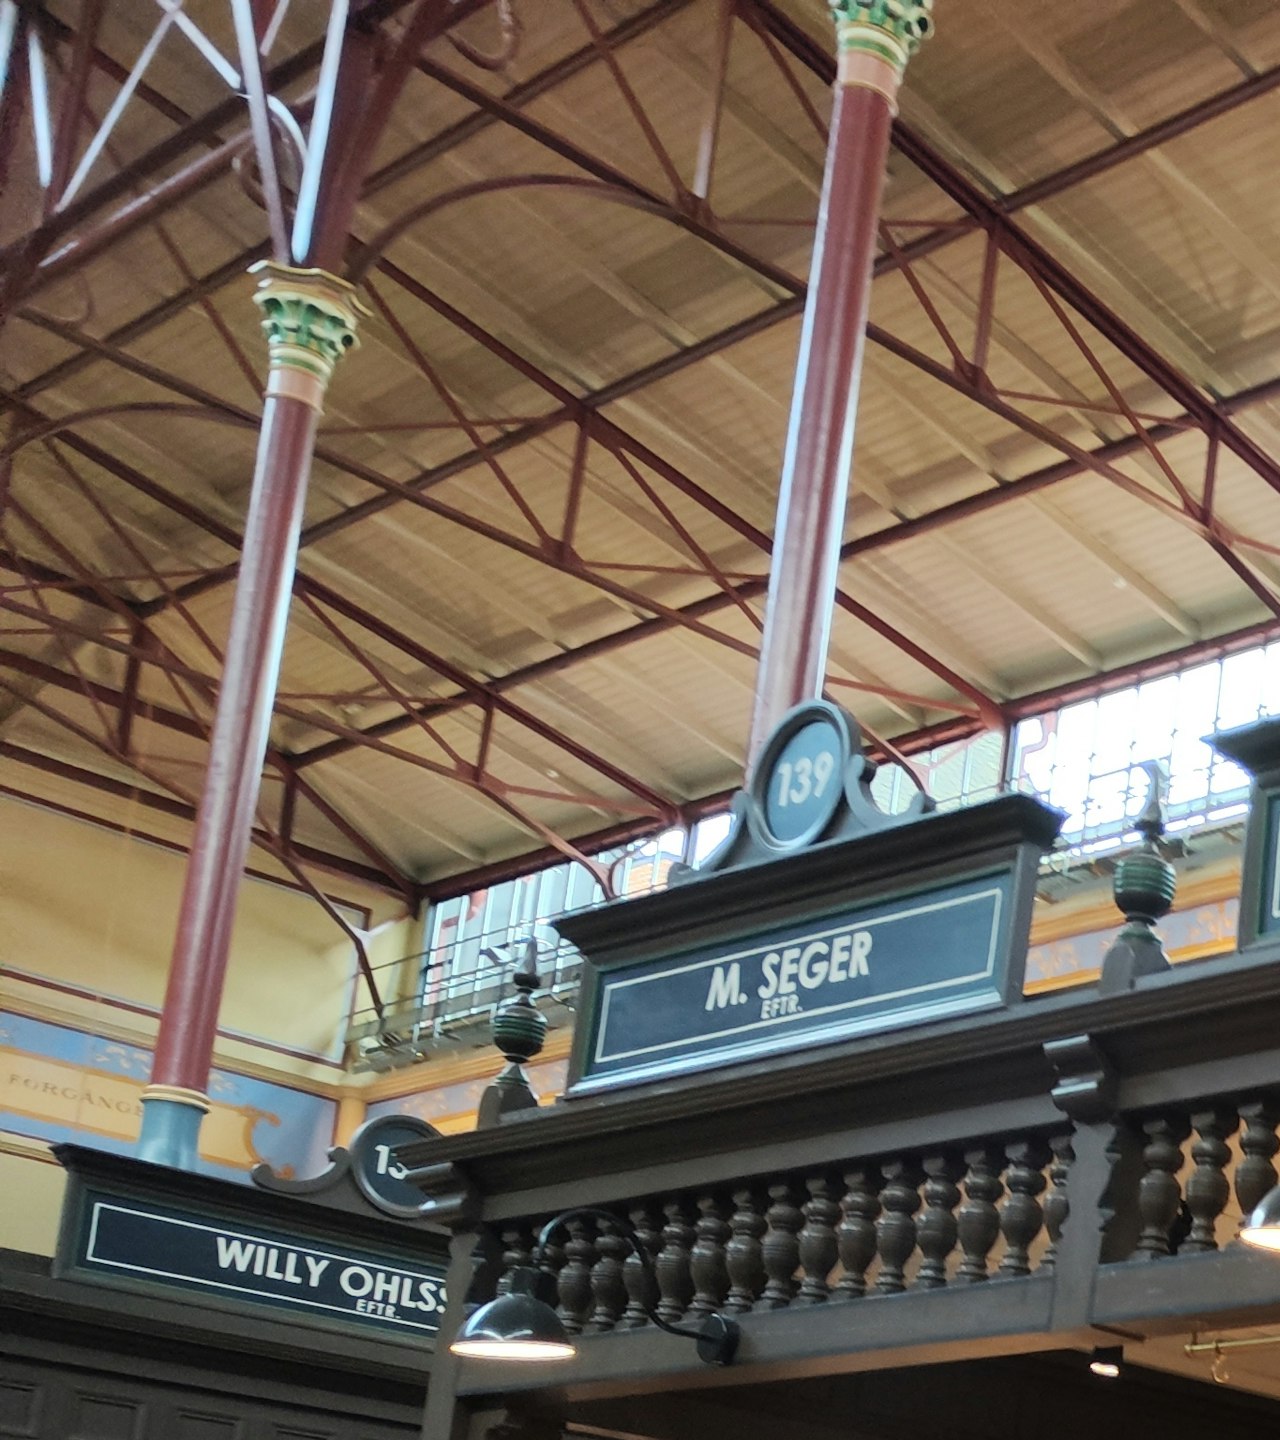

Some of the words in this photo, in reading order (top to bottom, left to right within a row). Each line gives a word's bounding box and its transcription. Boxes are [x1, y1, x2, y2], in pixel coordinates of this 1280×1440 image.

[777, 751, 833, 807] 139
[705, 966, 747, 1011] M.
[758, 931, 873, 1000] SEGER
[761, 992, 803, 1020] EFTR.
[217, 1236, 330, 1288] WILLY
[356, 1299, 401, 1319] EFTR.
